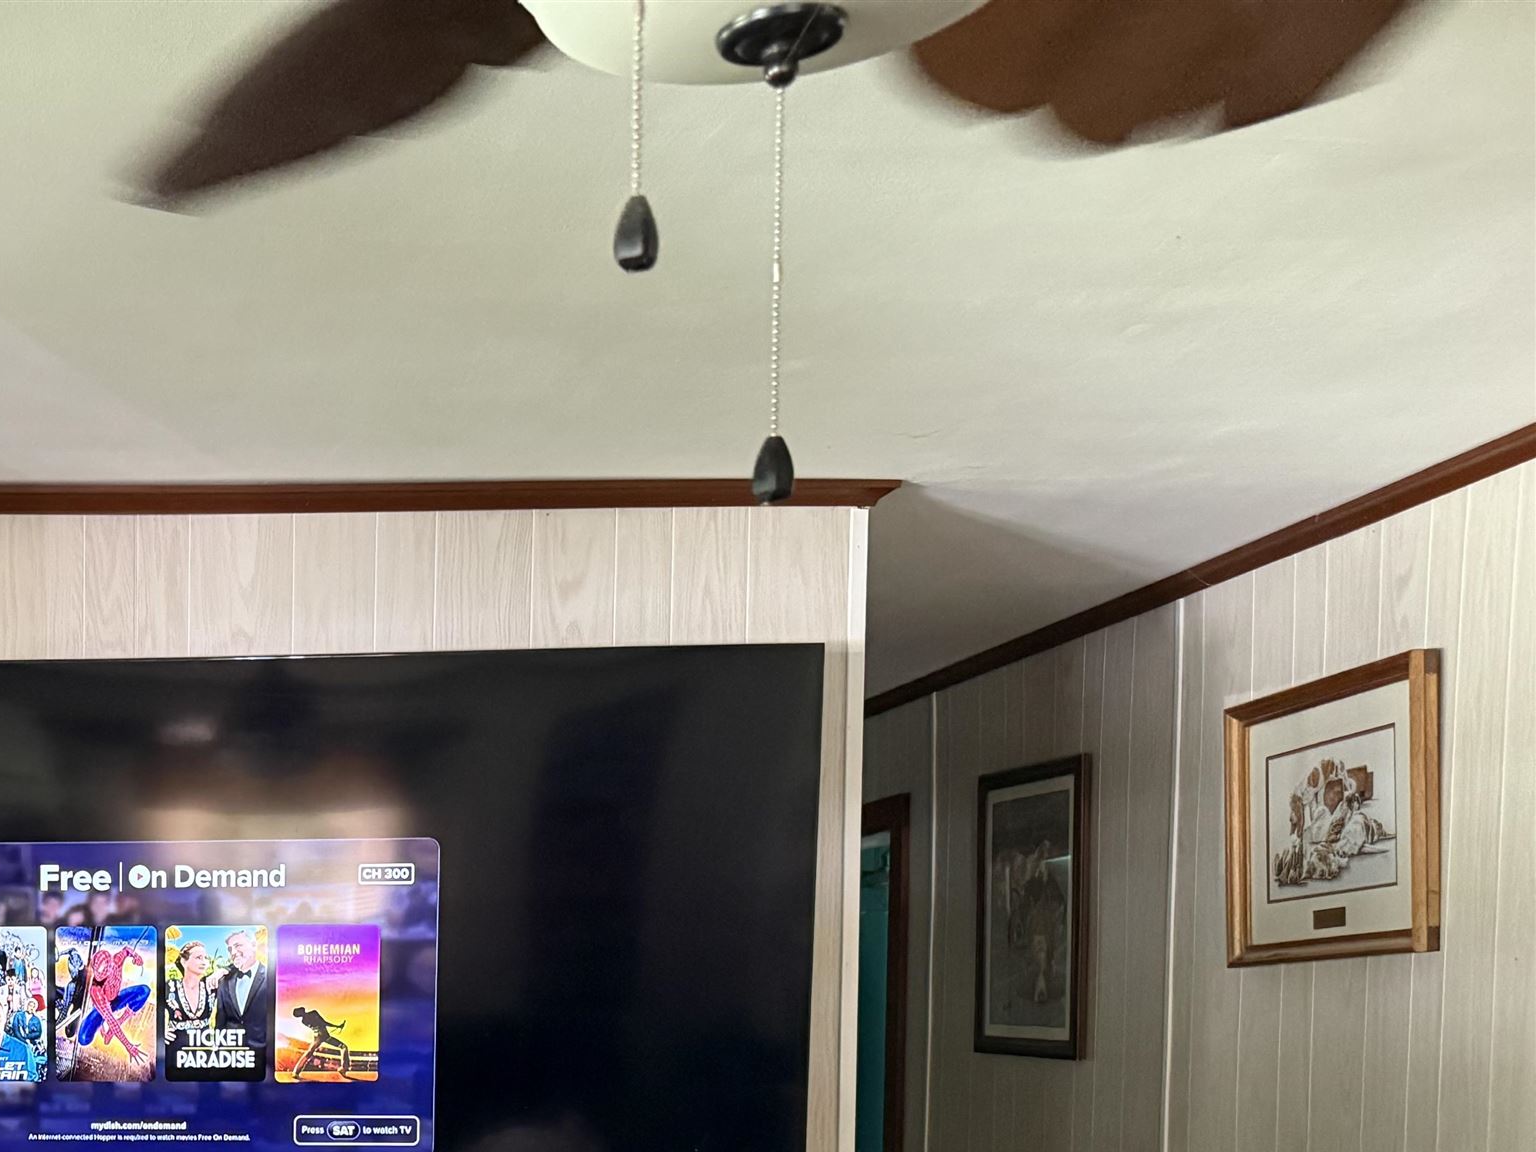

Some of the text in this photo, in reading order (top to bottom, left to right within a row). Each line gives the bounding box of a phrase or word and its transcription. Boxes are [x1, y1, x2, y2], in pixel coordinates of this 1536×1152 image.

[39, 864, 111, 891] Free
[128, 863, 286, 889] On Demand
[362, 868, 409, 880] CH 300
[297, 943, 361, 955] BOHEMIAN
[303, 955, 354, 965] RHAPSODY
[186, 1028, 246, 1046] TICKET
[176, 1050, 255, 1068] PARADISE
[91, 1121, 187, 1131] mydish.com/ondemand
[301, 1125, 412, 1136] Press SAT to watch TV
